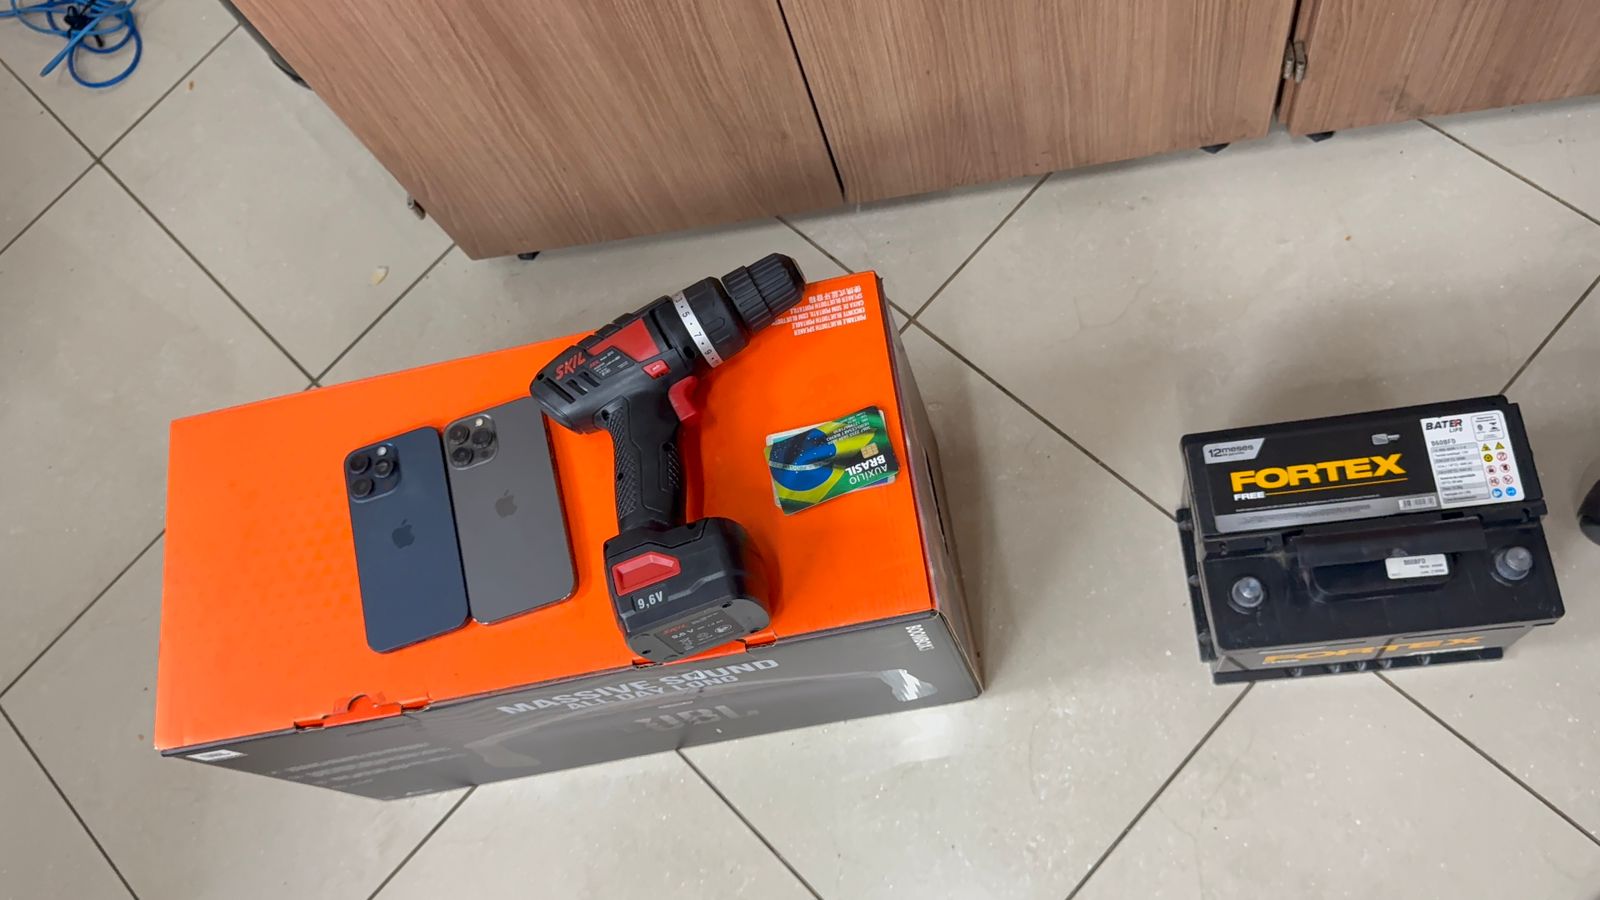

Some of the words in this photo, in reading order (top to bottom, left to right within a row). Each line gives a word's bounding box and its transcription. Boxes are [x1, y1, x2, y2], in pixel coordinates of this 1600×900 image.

[555, 352, 586, 380] SKIL
[1425, 418, 1463, 431] BATER
[845, 454, 886, 476] BRASIL
[849, 463, 888, 485] AUXÍLIO
[1230, 453, 1406, 492] FORTEX
[1233, 491, 1266, 501] FREE
[637, 590, 663, 609] 9,6V
[496, 680, 655, 715] MASSIVE
[659, 659, 780, 686] SOUND
[616, 687, 667, 701] DAY
[672, 675, 740, 692] LONG
